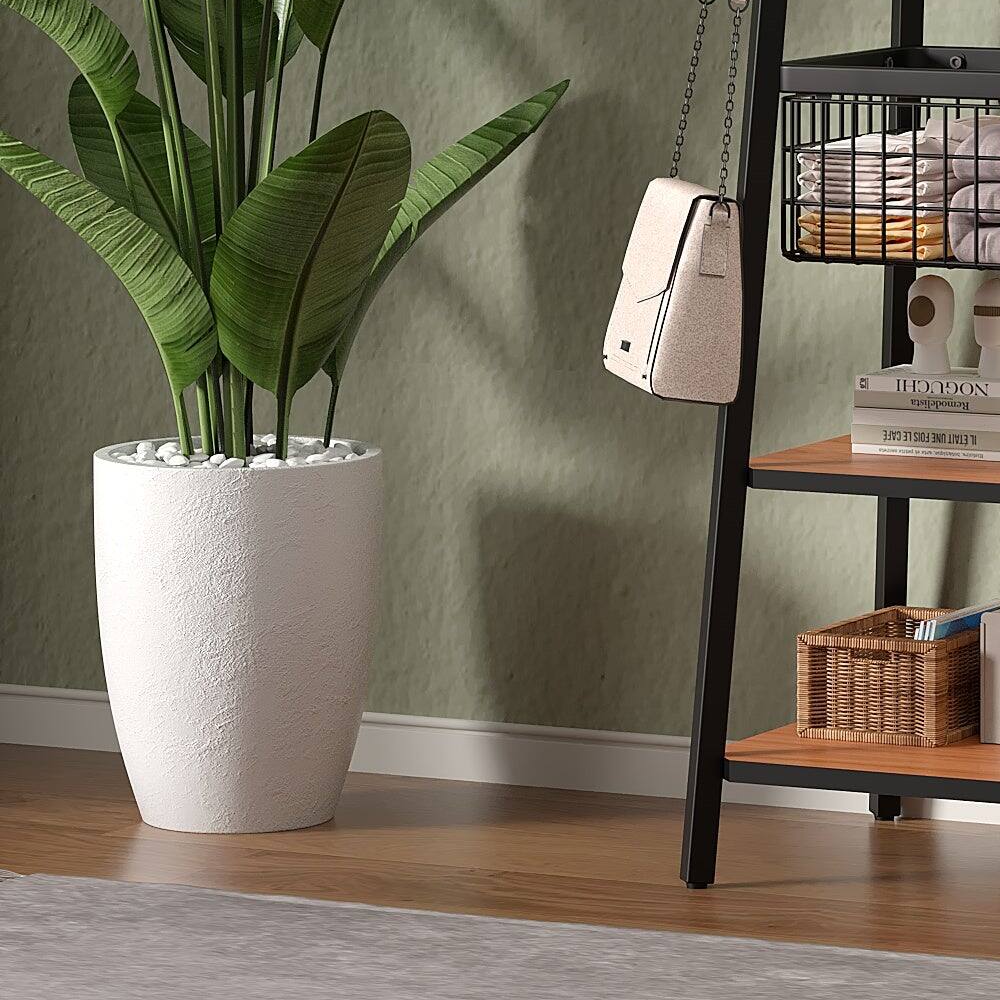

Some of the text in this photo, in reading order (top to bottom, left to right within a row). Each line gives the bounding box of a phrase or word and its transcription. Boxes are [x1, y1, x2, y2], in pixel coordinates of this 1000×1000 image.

[896, 378, 989, 397] NOGUCHI
[911, 398, 969, 411] Remodelista
[882, 429, 977, 447] IL ÉTAIT UNE FOIS LE CAFÉ
